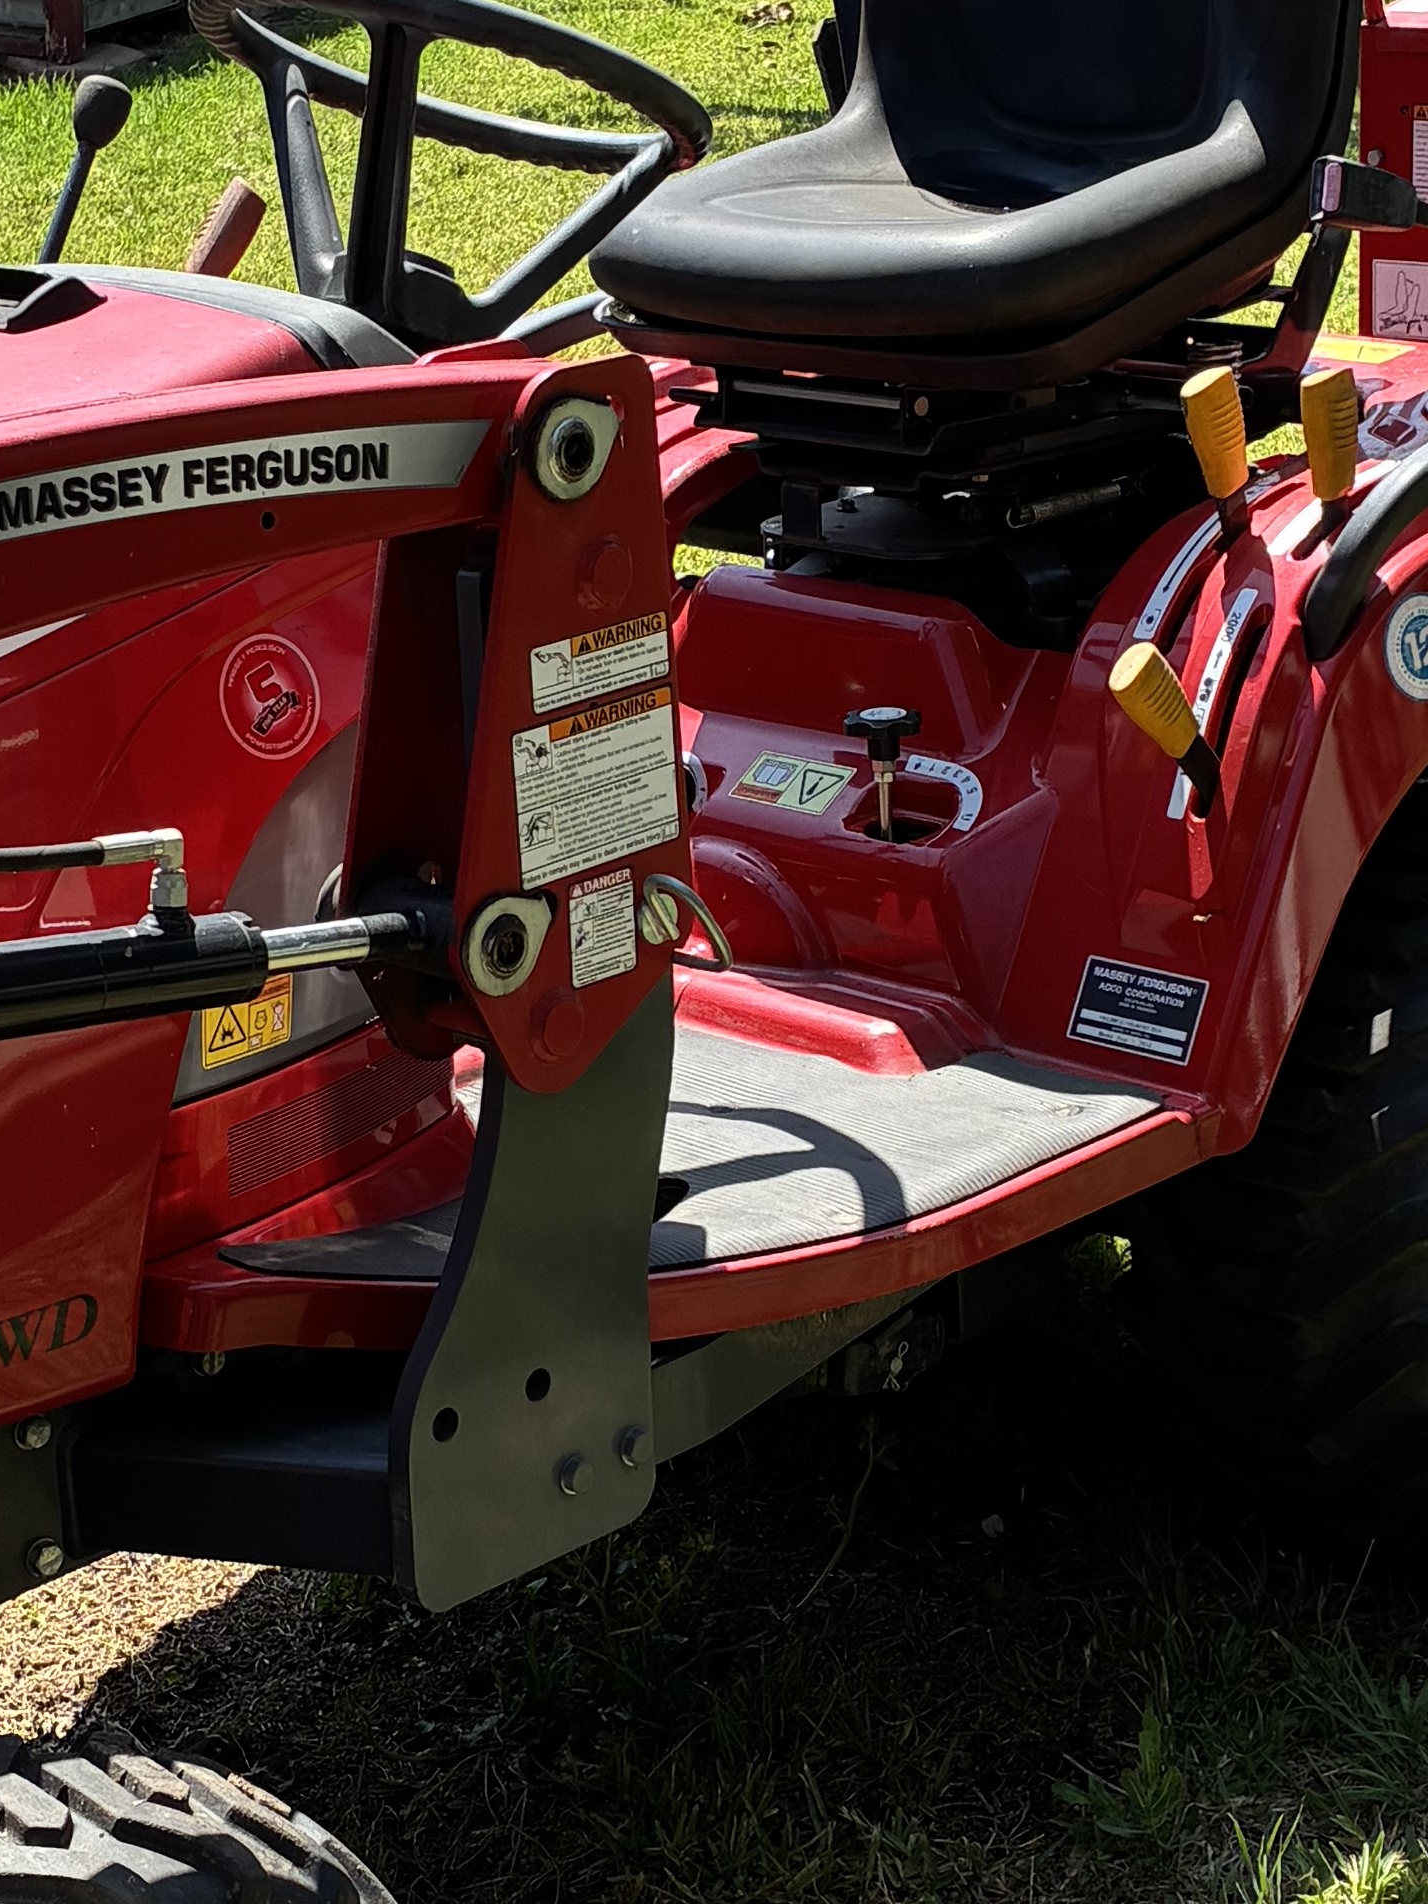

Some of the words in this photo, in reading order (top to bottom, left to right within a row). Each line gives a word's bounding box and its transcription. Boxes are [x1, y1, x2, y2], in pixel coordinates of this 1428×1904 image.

[182, 442, 389, 498] FERGUSON
[592, 614, 662, 646] WARNING
[1220, 611, 1242, 643] 2000
[584, 692, 657, 729] WARNING
[583, 869, 631, 893] DANGER
